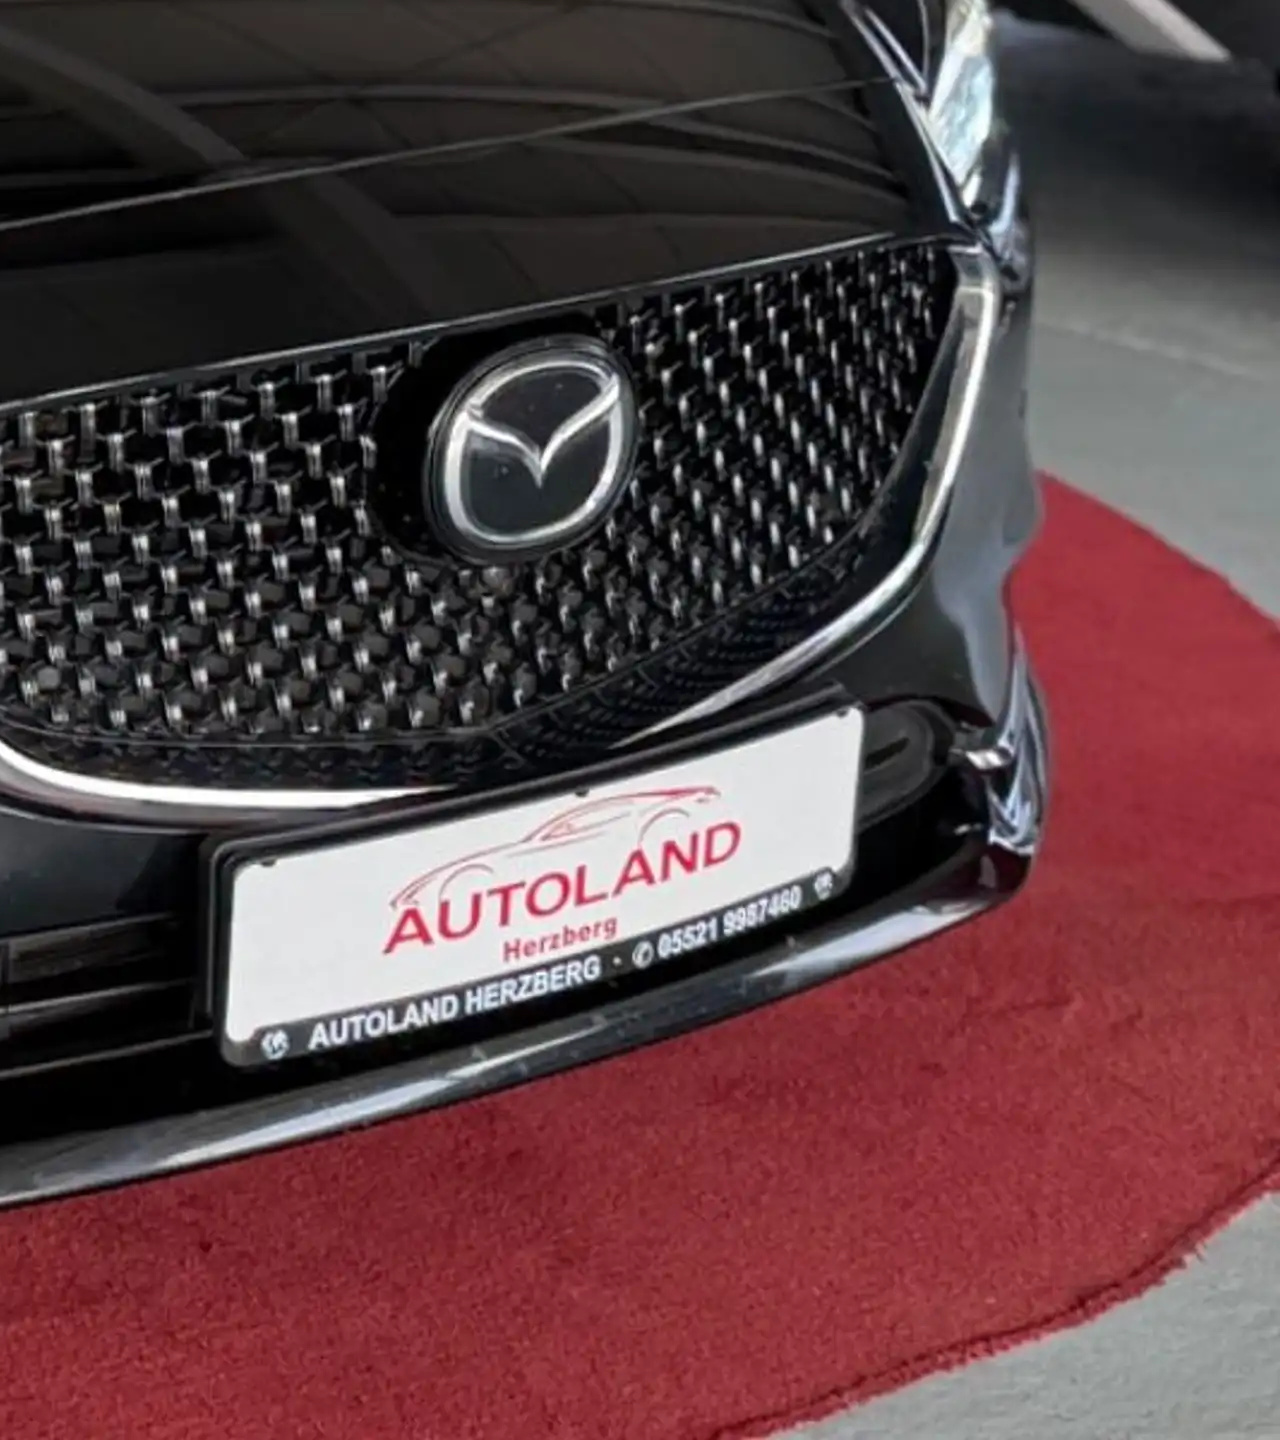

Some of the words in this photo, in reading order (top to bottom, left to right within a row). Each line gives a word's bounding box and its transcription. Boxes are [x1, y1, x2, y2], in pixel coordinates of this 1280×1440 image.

[382, 820, 743, 955] AUTOLAND
[502, 917, 618, 963] Herzberg
[307, 995, 460, 1051] AUTOLAND
[464, 956, 602, 1014] HERZBERG
[657, 917, 718, 959] 05521
[723, 884, 803, 936] 9987460
